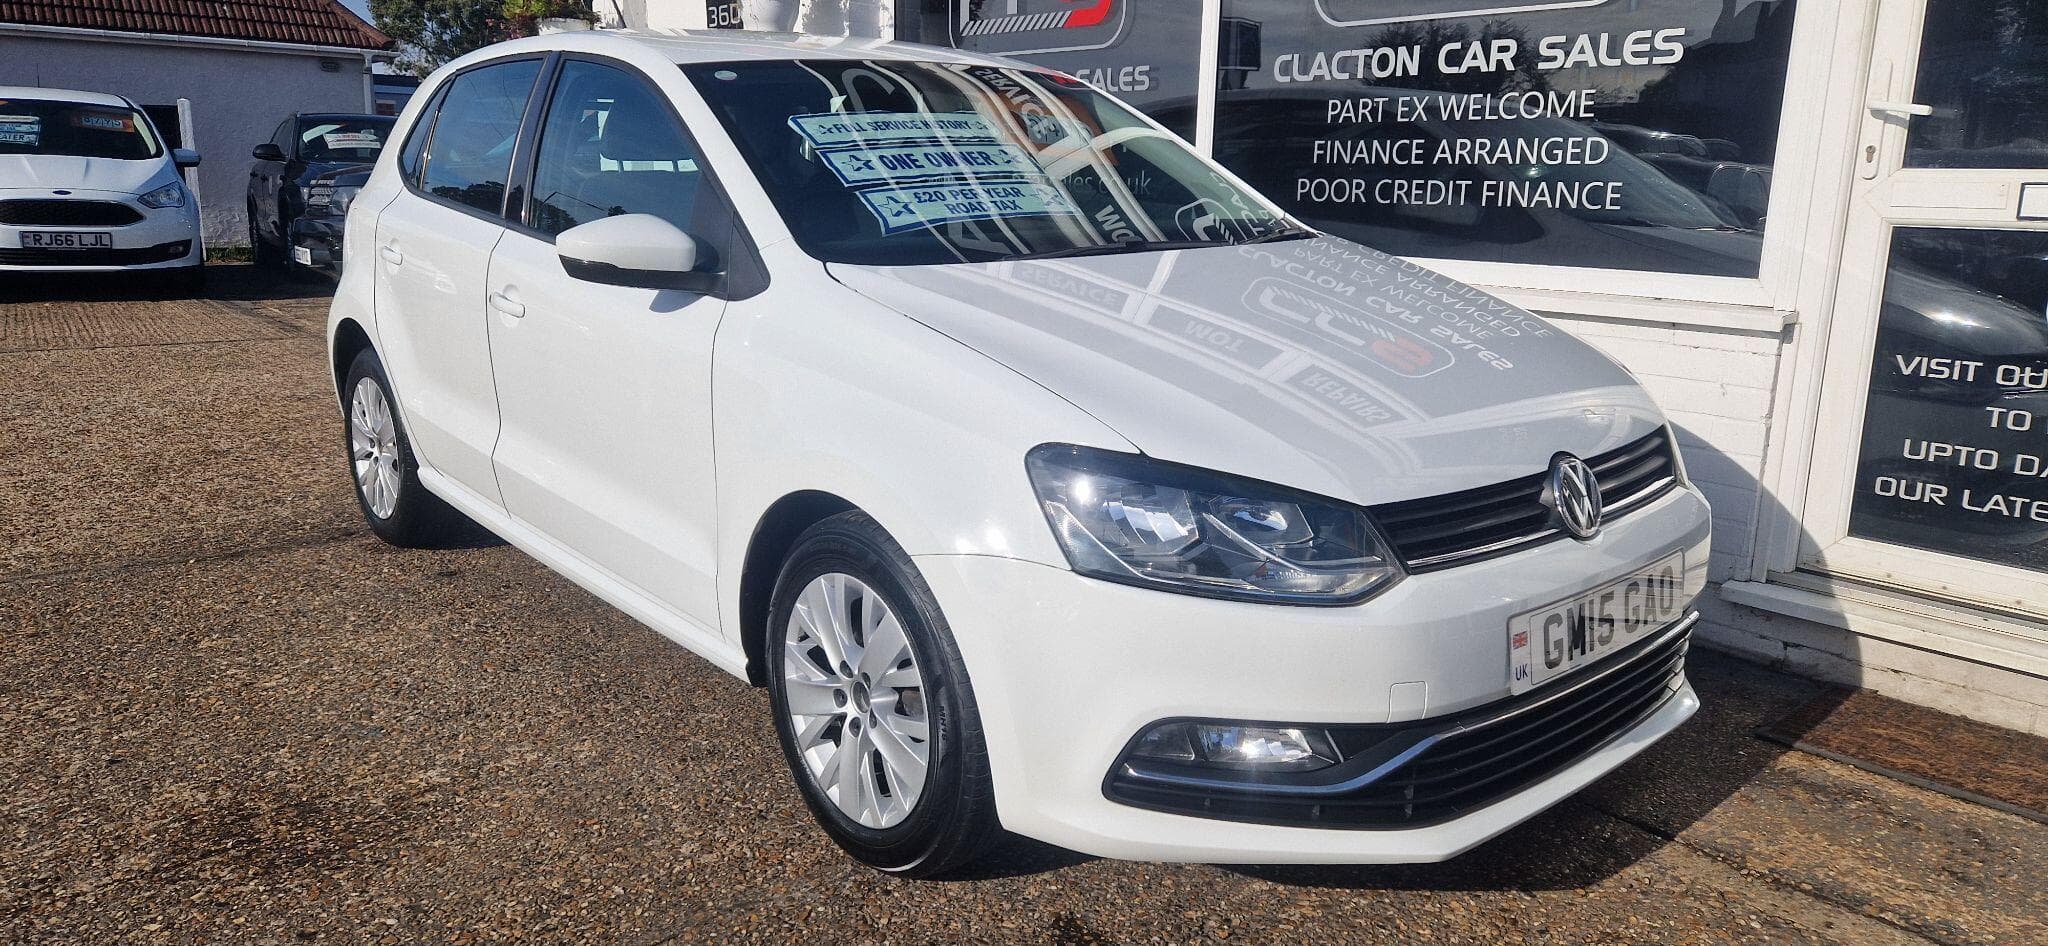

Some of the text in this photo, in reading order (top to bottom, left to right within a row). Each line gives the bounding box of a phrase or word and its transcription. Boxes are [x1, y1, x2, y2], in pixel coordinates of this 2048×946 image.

[1273, 27, 1686, 84] CLACTON CAR SALES
[1327, 89, 1595, 124] PART EX WELCOME
[833, 119, 972, 133] FULL SERVICE HSTORY
[878, 151, 998, 171] ONE OWNER
[1313, 137, 1609, 165] FINANCE ARRANGED
[913, 186, 1025, 204] £20 PER YEAR
[944, 200, 1024, 215] ROAD TAX
[1296, 178, 1623, 210] POOR CREDIT FINANCE
[32, 233, 110, 247] RJ66 LJL
[1896, 354, 1984, 382] VISIT
[1986, 407, 2032, 431] TO
[1902, 438, 1999, 470] UPTO
[1874, 476, 1949, 506] OUR
[1543, 591, 1616, 671] GM15
[1515, 663, 1529, 681] UK
